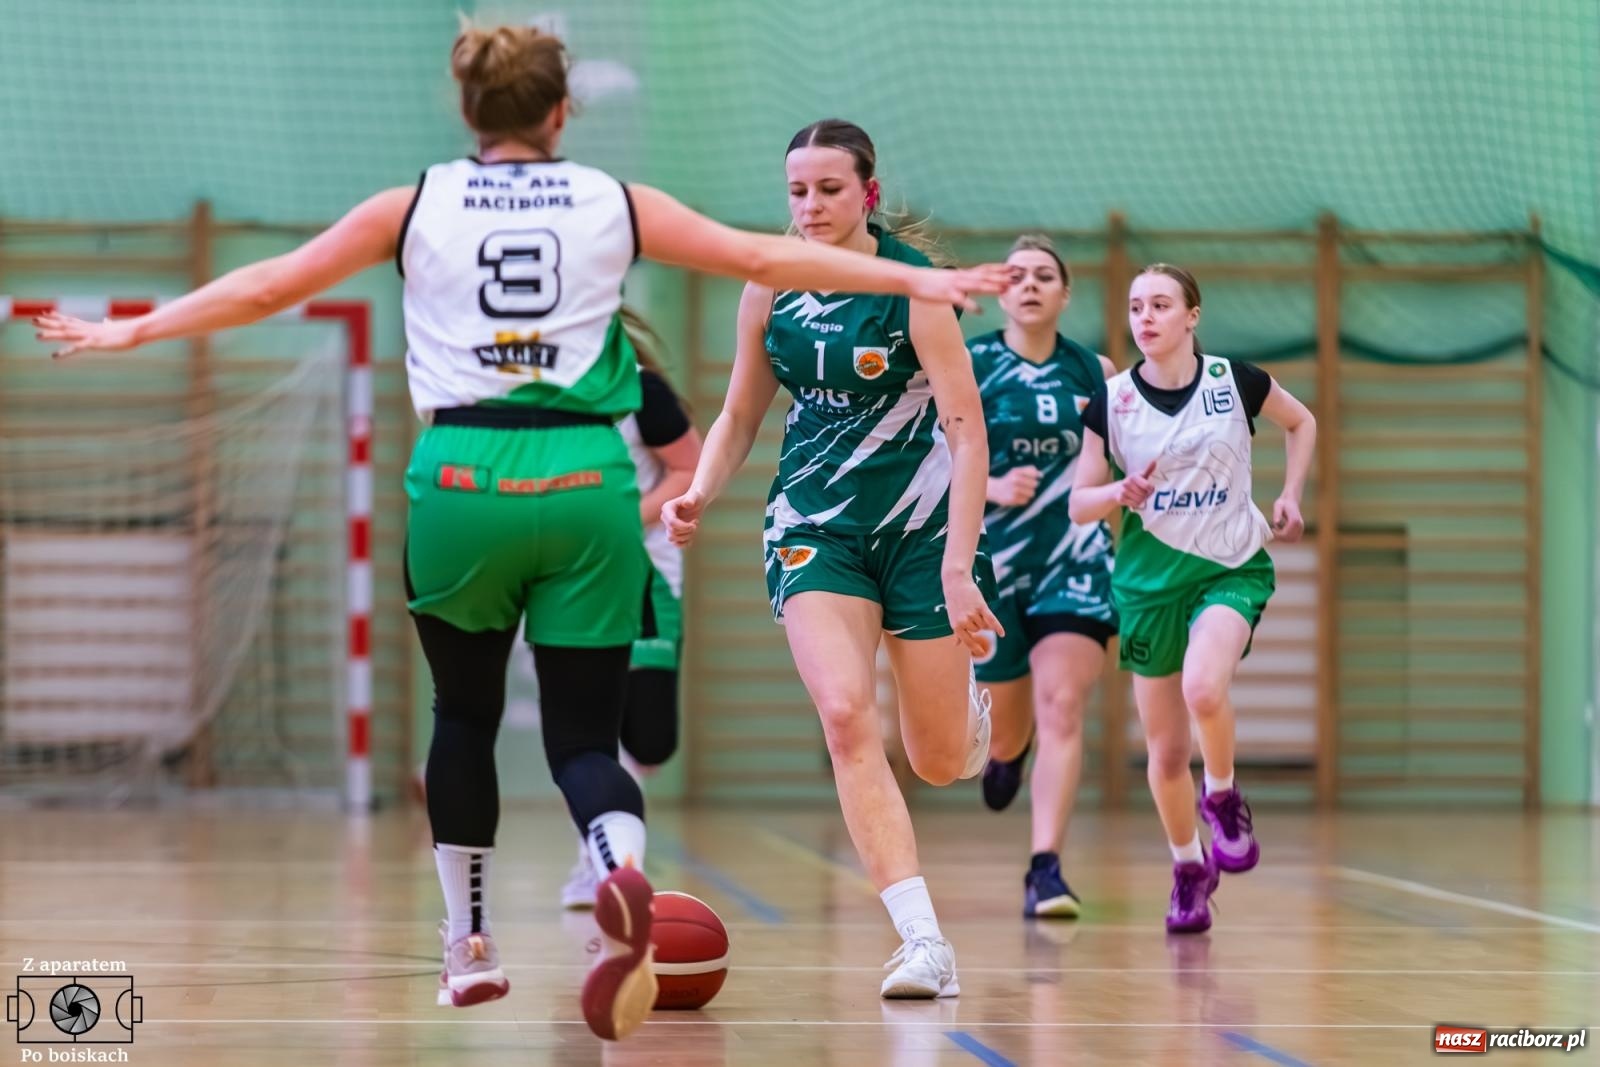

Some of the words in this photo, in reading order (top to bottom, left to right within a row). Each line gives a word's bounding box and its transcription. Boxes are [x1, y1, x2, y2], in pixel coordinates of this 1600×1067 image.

[478, 227, 561, 318] 3
[801, 320, 844, 333] regio
[814, 340, 826, 380] 1
[1036, 394, 1058, 424] 8
[1202, 385, 1235, 416] 15
[1154, 483, 1229, 511] Clavis
